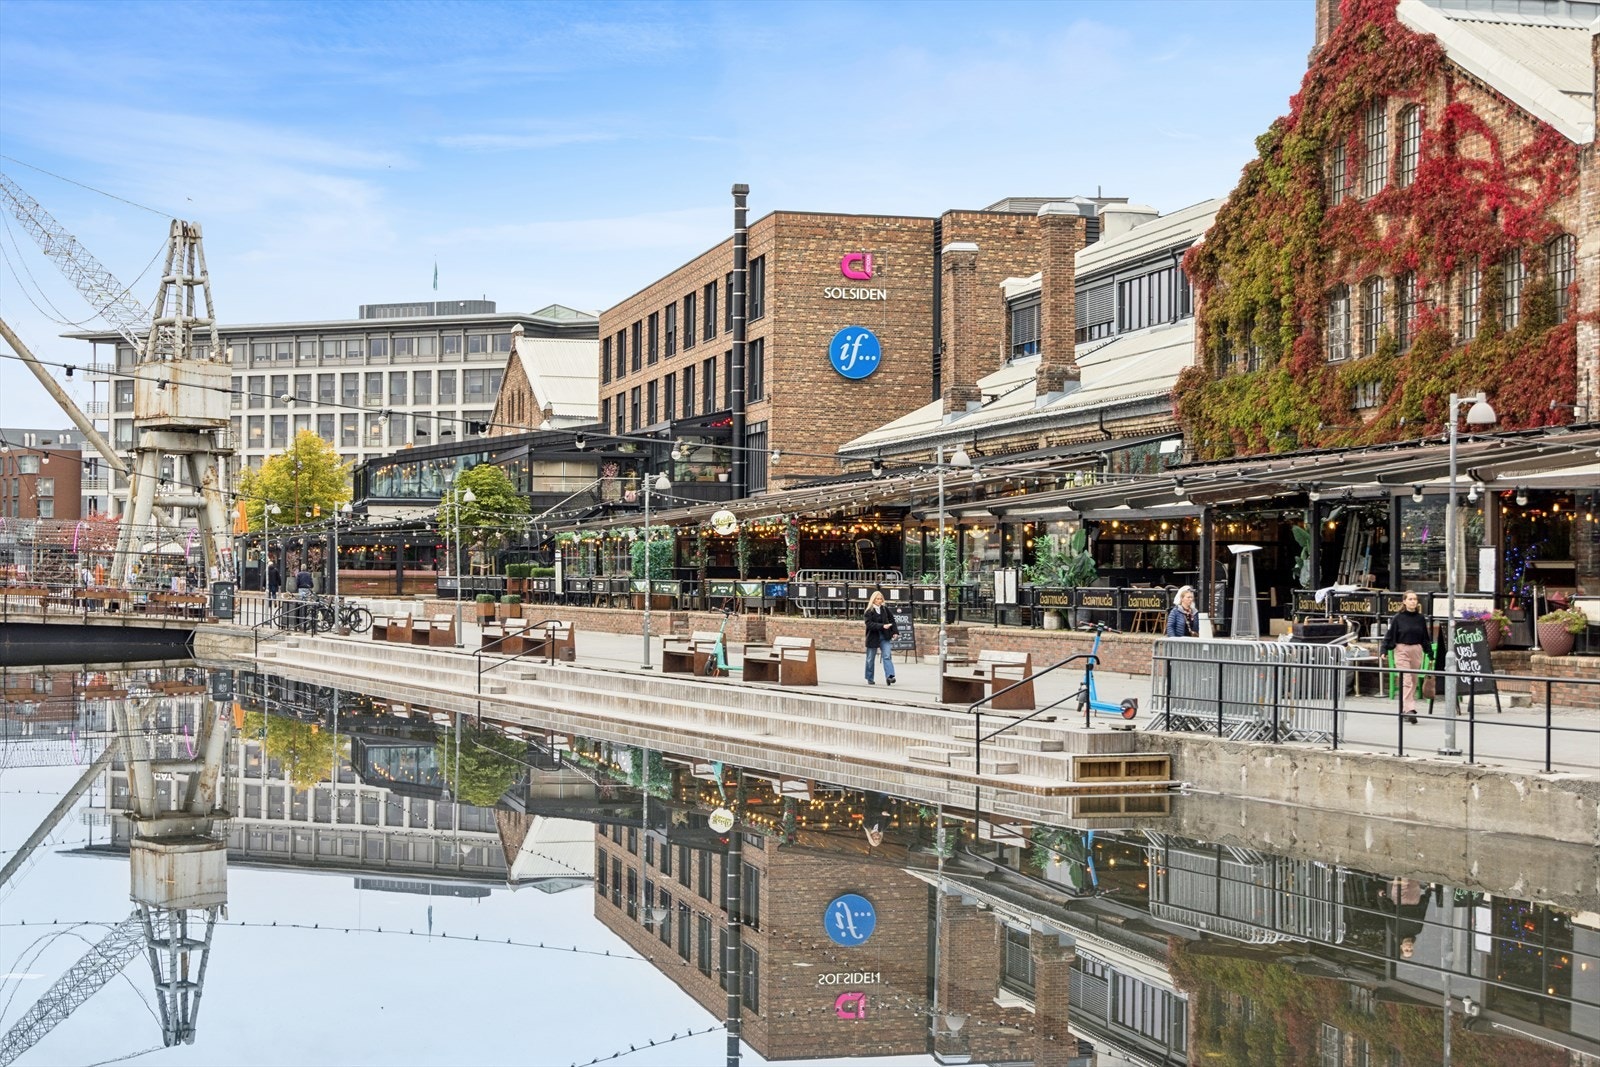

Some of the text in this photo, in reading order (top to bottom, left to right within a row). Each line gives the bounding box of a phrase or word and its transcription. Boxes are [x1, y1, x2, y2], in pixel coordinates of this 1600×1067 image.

[824, 287, 887, 300] SOLSIDEN
[1039, 592, 1068, 605] barmuda
[1082, 593, 1113, 607] barmuda
[1128, 593, 1161, 607] barmuda
[1340, 598, 1371, 612] barmuda
